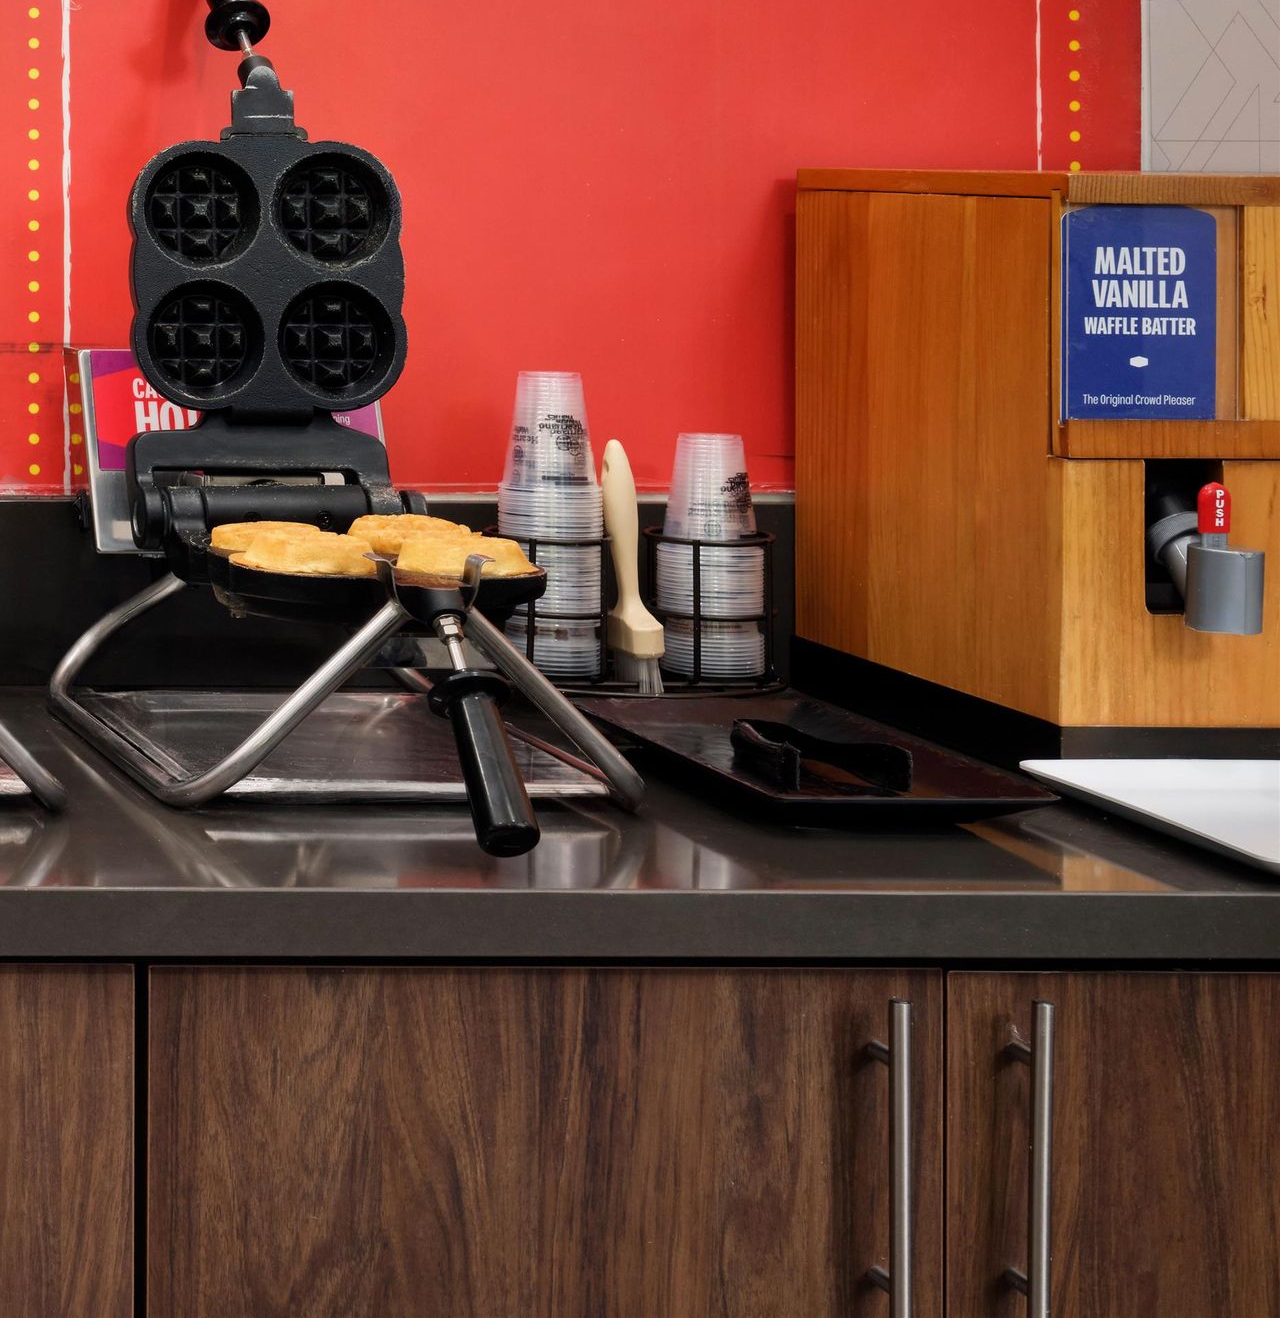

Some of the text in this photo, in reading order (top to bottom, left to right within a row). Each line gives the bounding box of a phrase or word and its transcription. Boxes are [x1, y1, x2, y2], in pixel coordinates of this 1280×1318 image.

[1094, 246, 1187, 276] MALTED
[1091, 279, 1189, 309] VANILLA
[1083, 316, 1197, 336] WAFFLE BATTER
[1083, 393, 1197, 408] The Original Crowd Pleaser
[1215, 489, 1225, 527] PUSH
